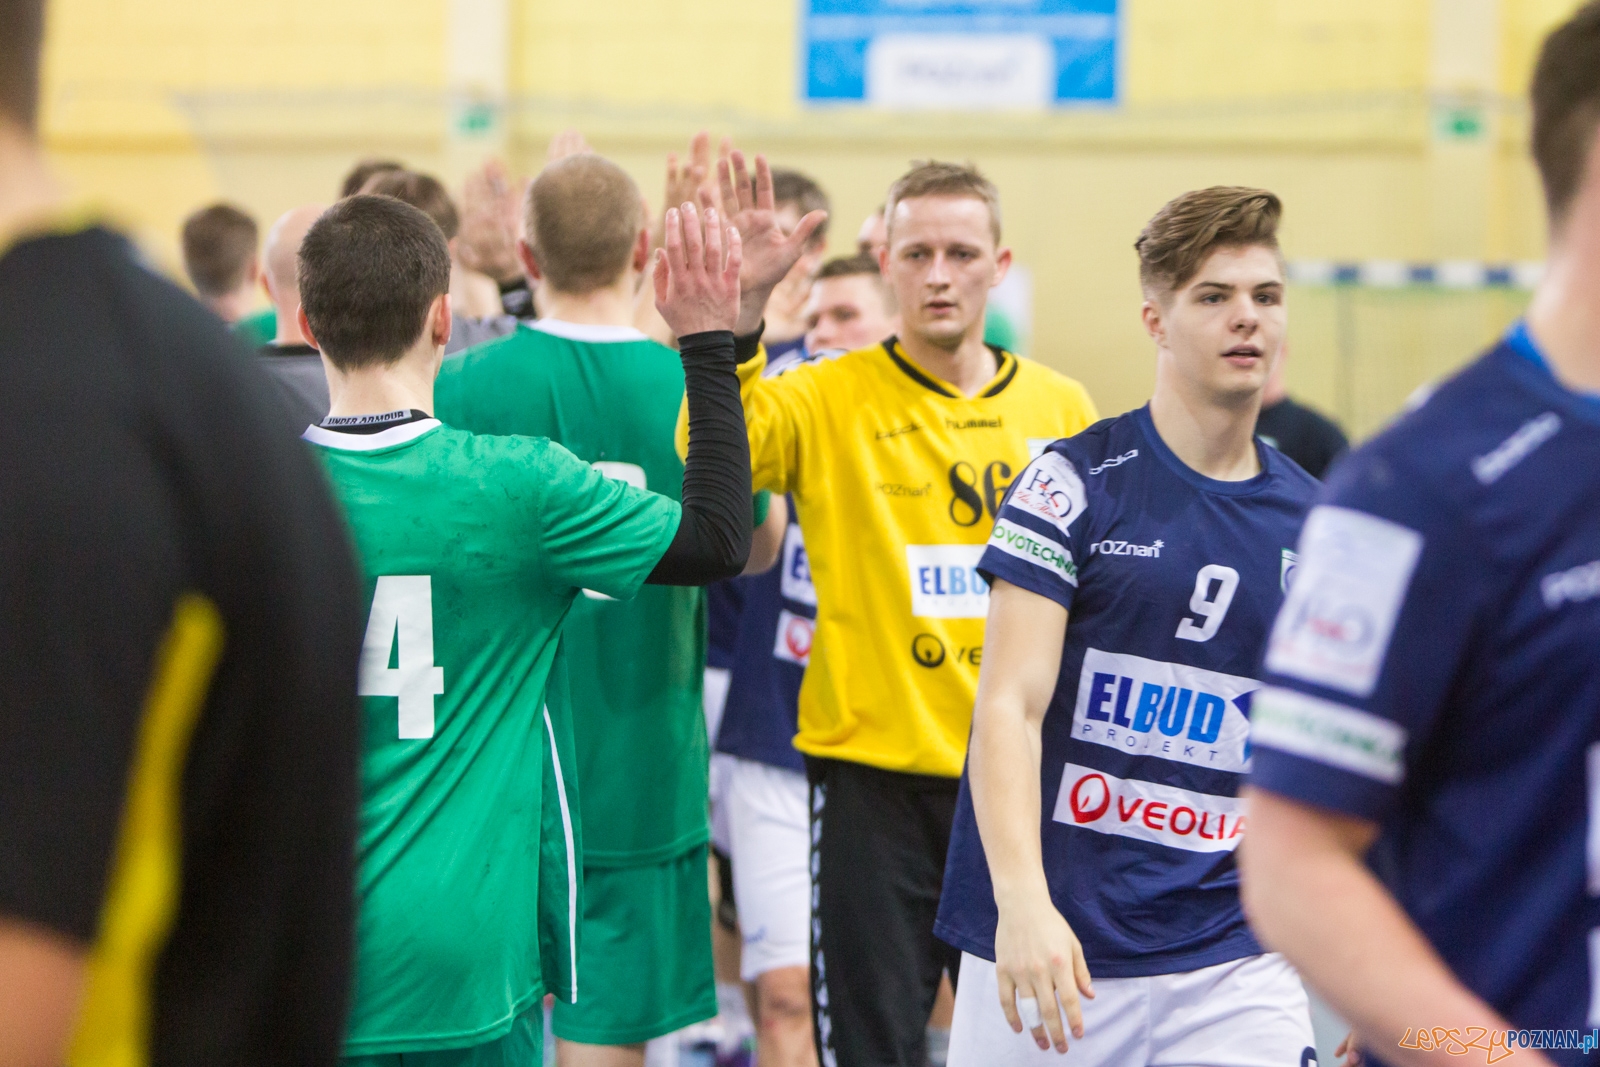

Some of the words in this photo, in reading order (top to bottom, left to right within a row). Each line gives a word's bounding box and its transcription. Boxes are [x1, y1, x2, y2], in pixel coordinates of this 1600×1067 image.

[327, 417, 358, 425] UNDER
[359, 411, 404, 424] ARMOUR
[945, 415, 1002, 430] hummel
[948, 461, 1012, 527] 86
[1174, 563, 1240, 643] 9
[357, 575, 445, 739] 4
[1085, 671, 1226, 744] ELBUD
[1082, 723, 1218, 761] PROJEKT
